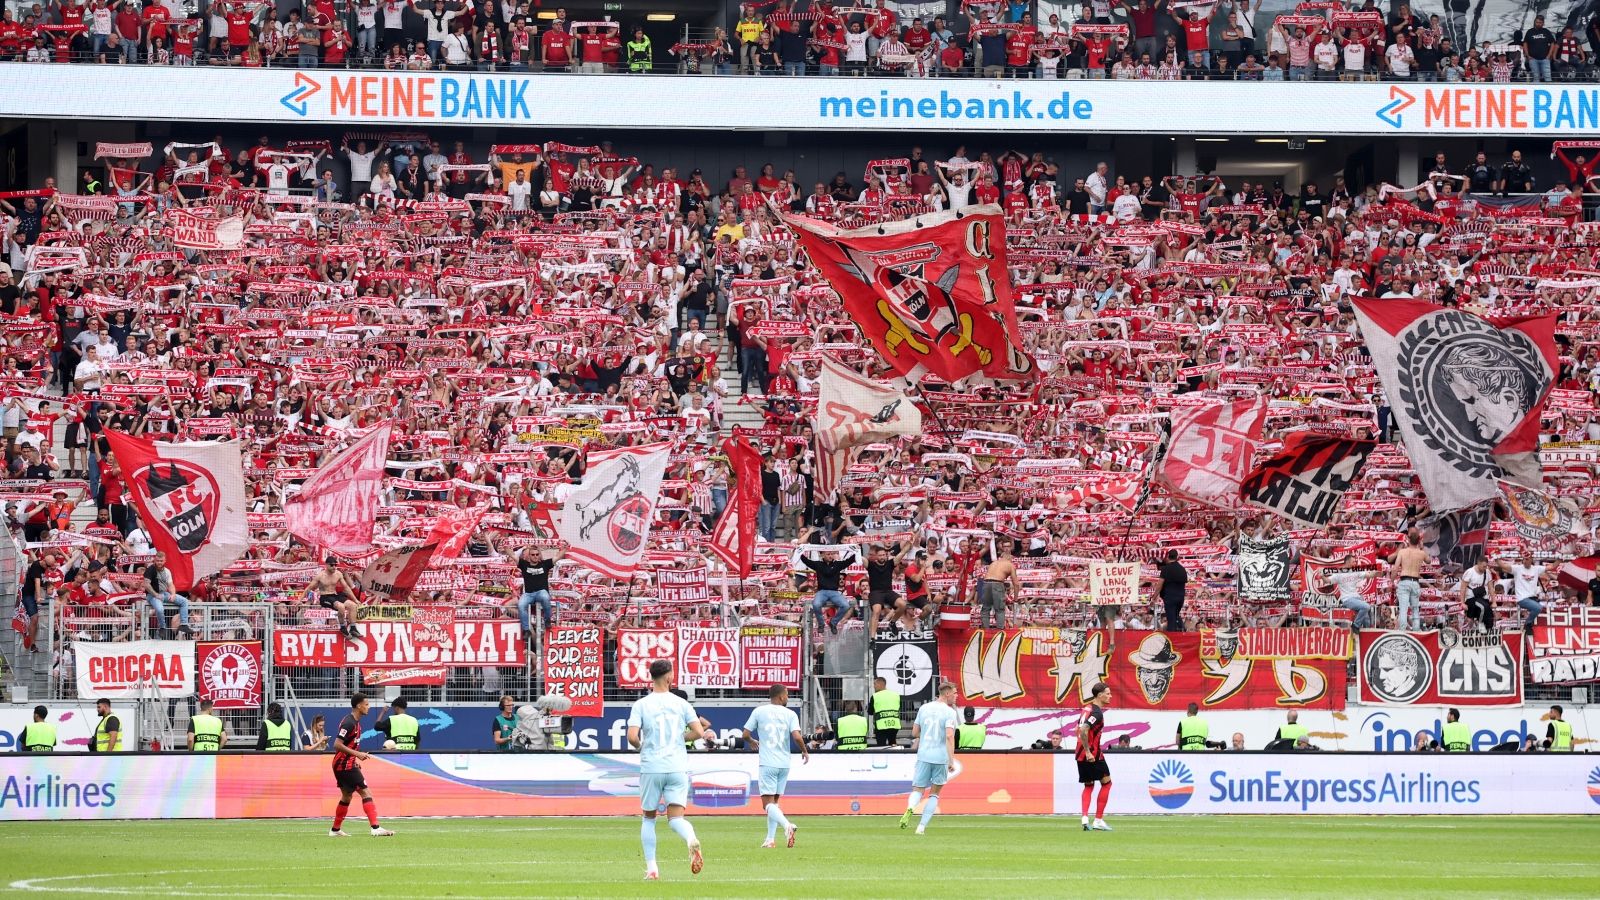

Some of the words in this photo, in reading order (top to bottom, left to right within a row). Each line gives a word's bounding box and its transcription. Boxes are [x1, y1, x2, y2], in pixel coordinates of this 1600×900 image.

[820, 90, 1092, 119] meinebank.de
[178, 215, 214, 231] ROTE
[176, 228, 216, 244] WAND
[1439, 310, 1483, 338] CNS
[1100, 588, 1132, 596] ULTRAS
[280, 632, 337, 657] RVT
[549, 630, 600, 644] LEEVER
[620, 632, 674, 658] SPS
[682, 630, 736, 641] CHAOTIX
[875, 630, 934, 642] HORDE
[1238, 627, 1350, 656] STADIONVERBOT
[547, 646, 582, 665] DUD
[583, 646, 598, 655] ALS
[1033, 642, 1072, 656] Horde
[89, 654, 184, 682] CRICCAA
[583, 656, 598, 664] ENE
[1440, 648, 1512, 691] CNS
[548, 662, 600, 679] KNÄÄCH
[707, 674, 736, 686] KÖLN
[1533, 658, 1600, 683] RAD
[548, 682, 564, 696] ZE
[569, 680, 598, 698] SIN!
[924, 717, 940, 740] 21
[1373, 718, 1528, 752] inded
[0, 774, 116, 808] Airlines
